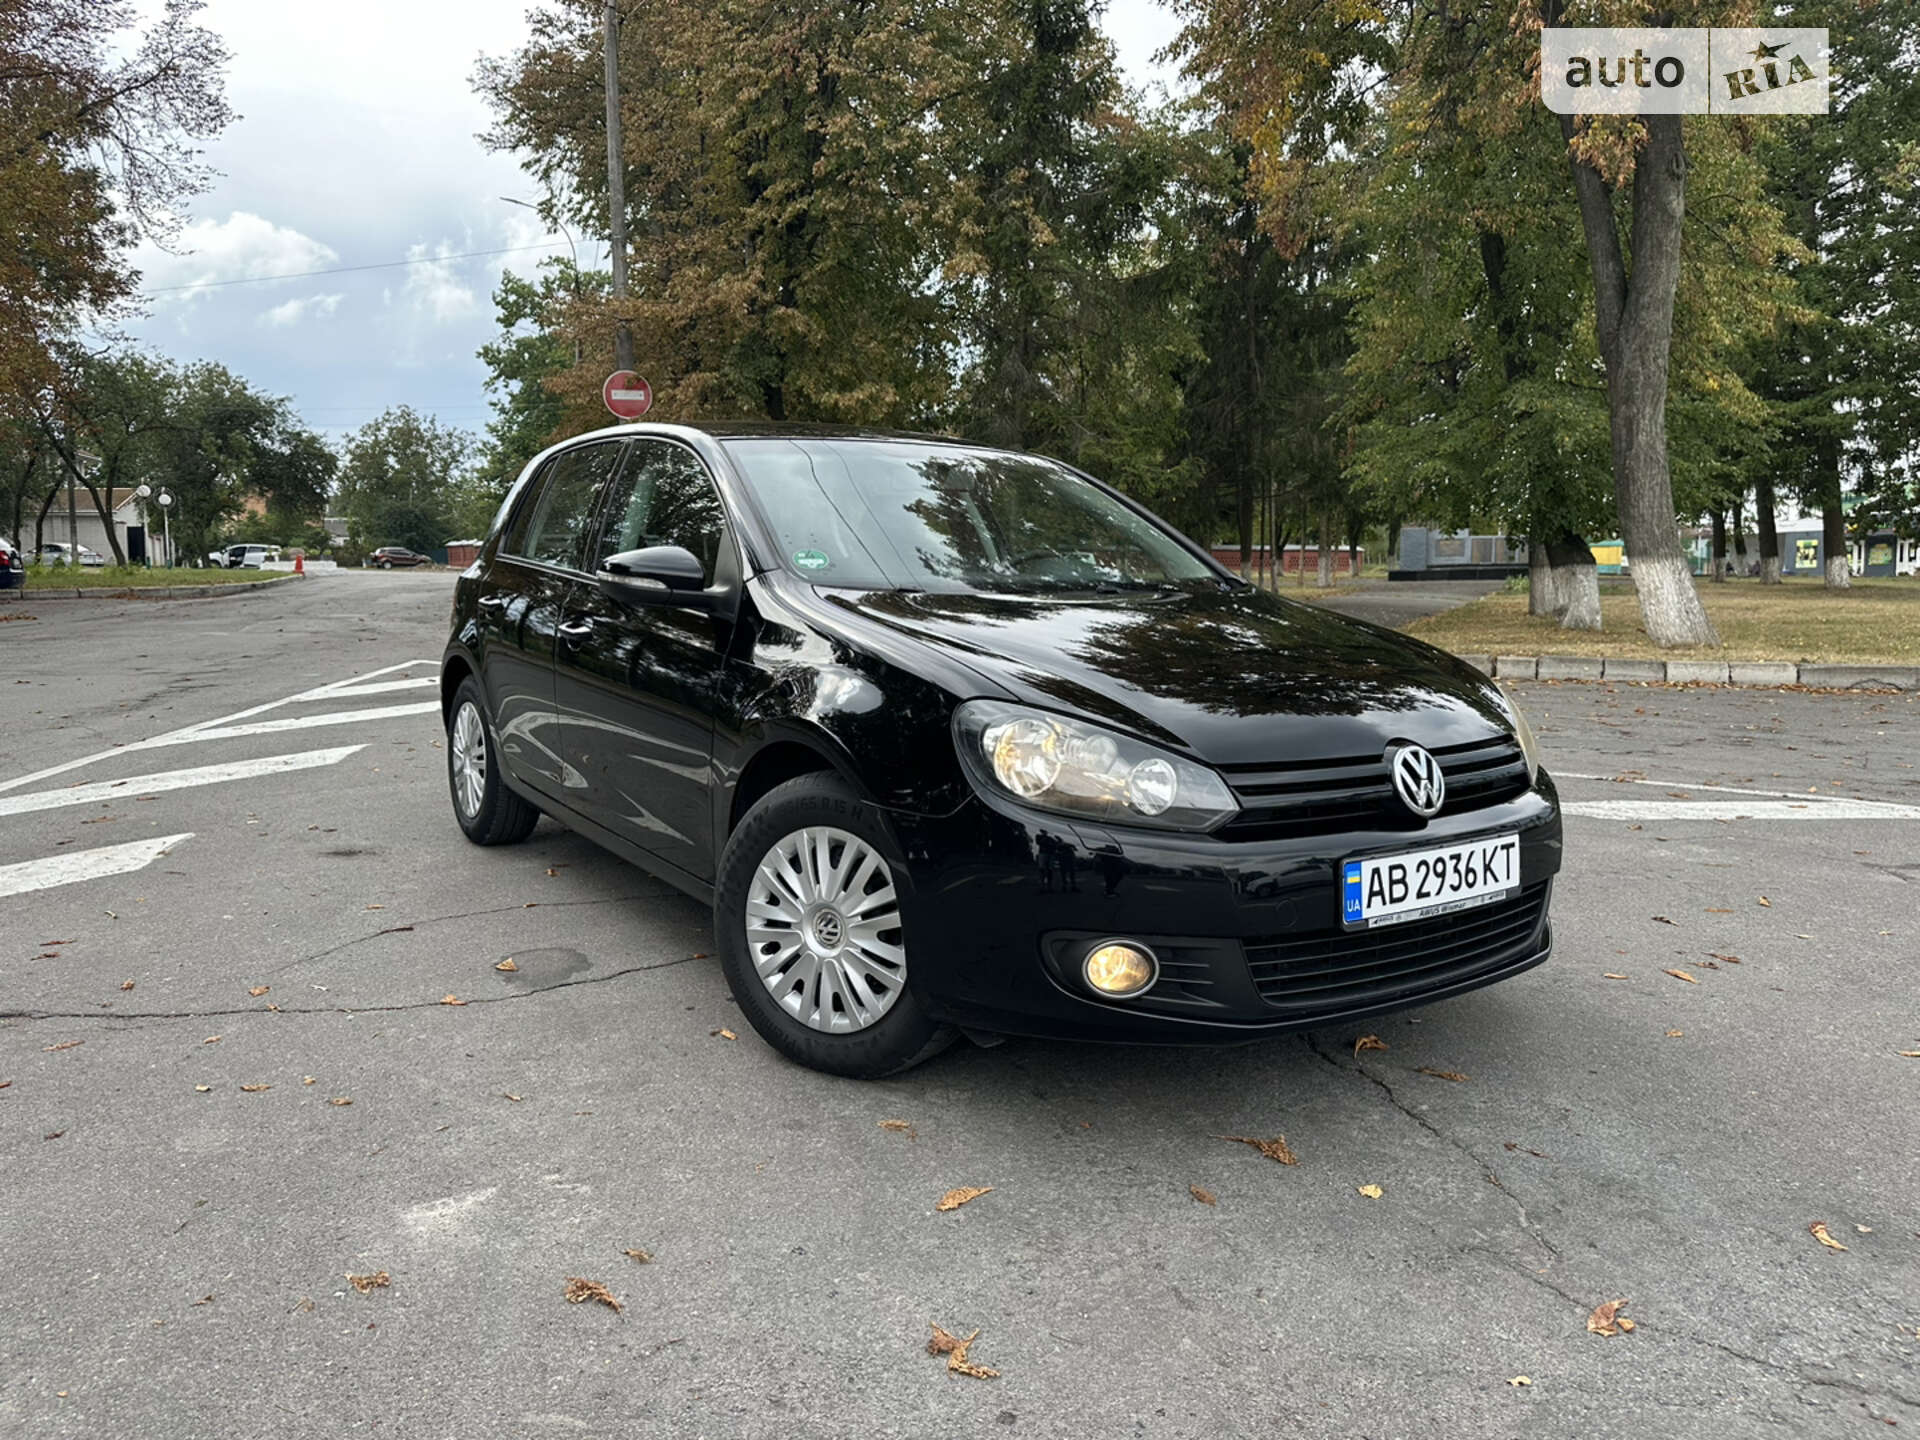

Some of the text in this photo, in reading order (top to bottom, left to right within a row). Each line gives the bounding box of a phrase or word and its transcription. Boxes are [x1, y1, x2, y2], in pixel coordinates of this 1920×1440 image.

[1366, 842, 1516, 909] AB 2936 KT
[1346, 898, 1361, 912] UA
